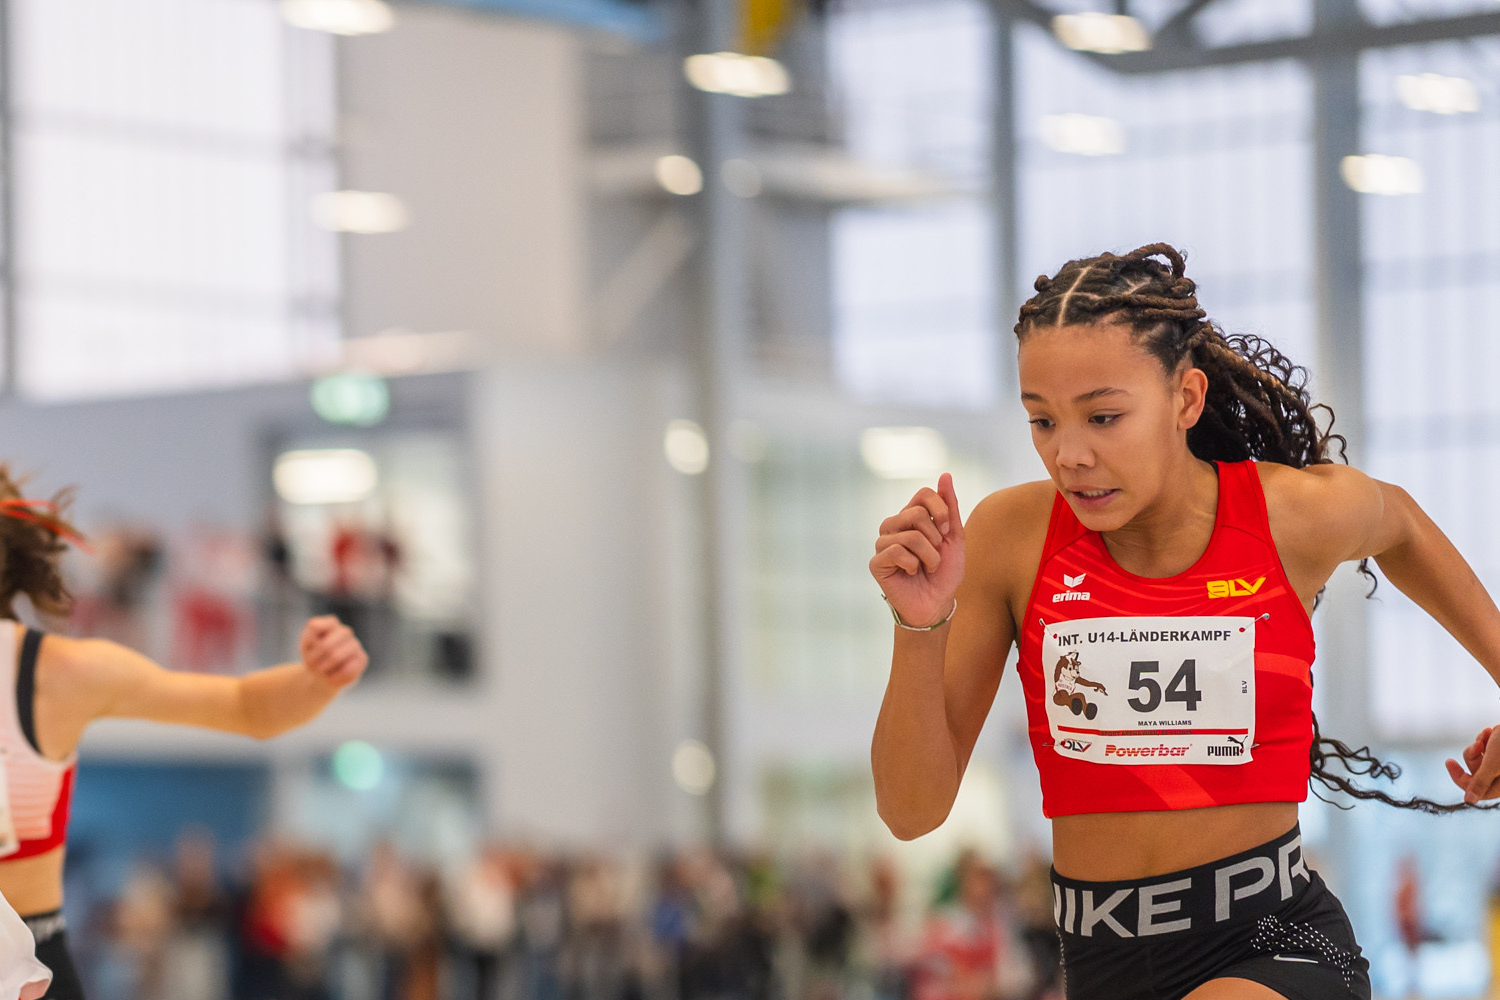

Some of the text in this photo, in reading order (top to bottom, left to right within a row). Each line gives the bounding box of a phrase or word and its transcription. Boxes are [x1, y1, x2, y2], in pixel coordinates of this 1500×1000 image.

[1052, 590, 1091, 603] erima
[1206, 577, 1266, 599] BLV
[1058, 629, 1231, 647] INT. U14-LÄNDERKAMPF
[1127, 659, 1202, 713] 54
[1104, 743, 1190, 757] Powerbar
[1207, 745, 1240, 757] PUMA
[1214, 834, 1311, 923] PR
